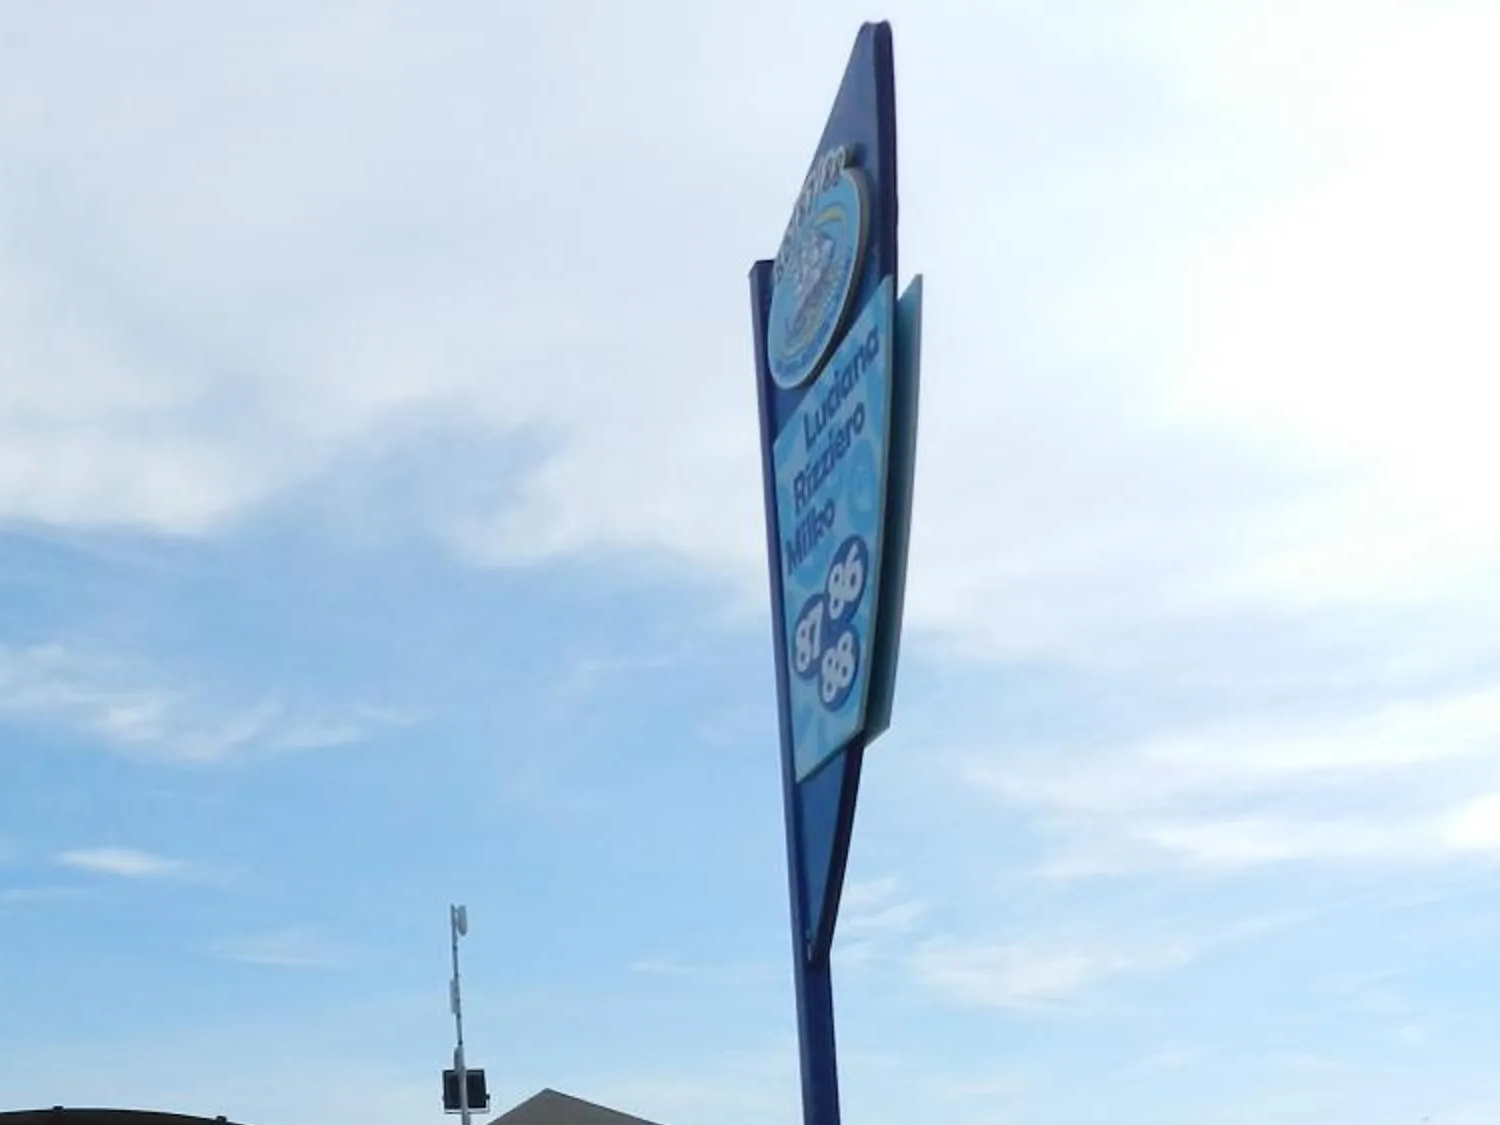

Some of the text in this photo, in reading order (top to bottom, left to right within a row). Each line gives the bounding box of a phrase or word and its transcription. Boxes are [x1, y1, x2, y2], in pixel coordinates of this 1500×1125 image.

[803, 324, 880, 452] Luciana
[793, 402, 866, 514] Rizziero
[786, 498, 836, 576] Milko
[828, 541, 864, 619] 86
[795, 600, 824, 673] 87
[821, 630, 855, 703] 88
